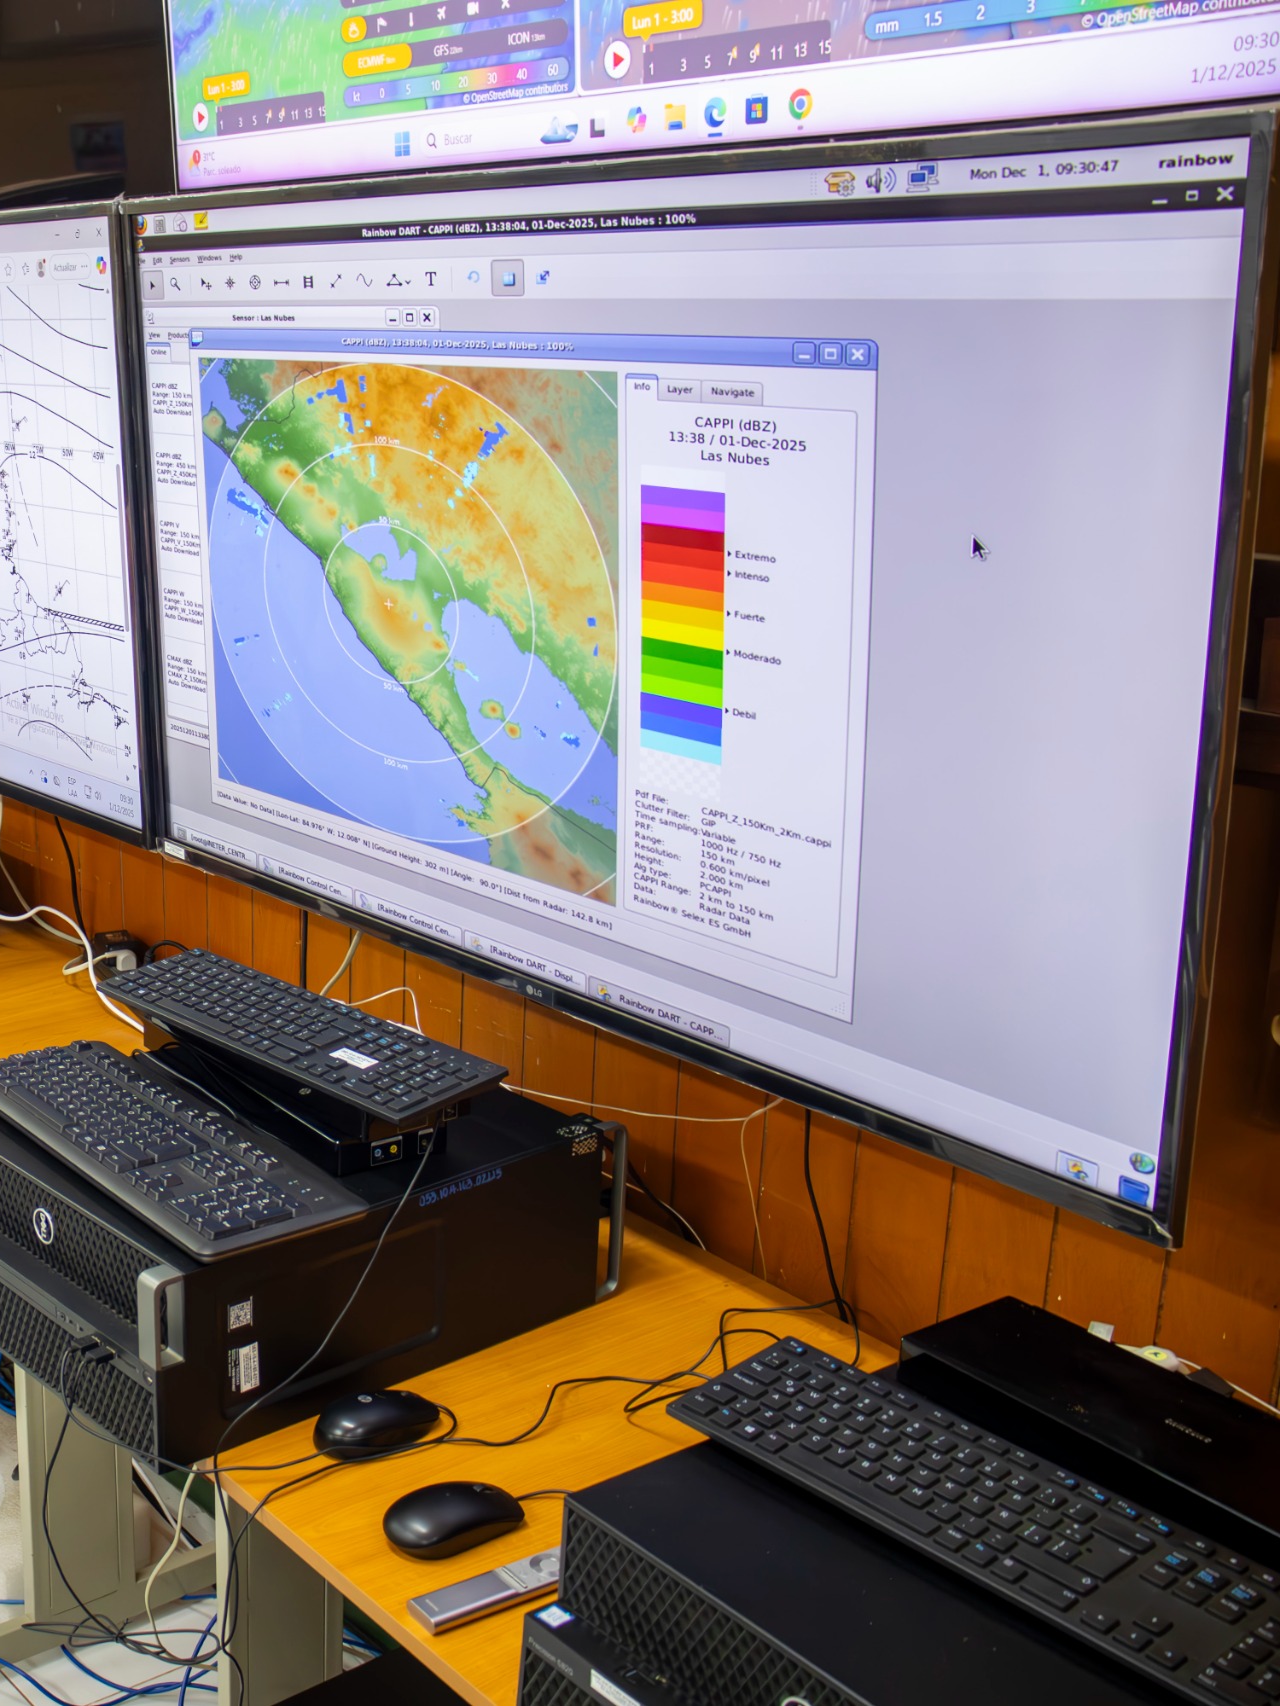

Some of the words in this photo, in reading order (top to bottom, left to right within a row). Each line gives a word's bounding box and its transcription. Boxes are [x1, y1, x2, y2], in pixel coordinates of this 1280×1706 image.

[632, 14, 651, 30] Lun
[654, 12, 660, 25] 1
[671, 7, 694, 23] 3:00
[875, 20, 899, 34] mm
[924, 11, 943, 27] 1.5
[976, 4, 985, 21] 2
[1096, 1, 1199, 27] OpenStreetMap
[507, 32, 530, 45] ICON
[1233, 31, 1280, 52] 09:30
[357, 53, 386, 69] ECMWF
[433, 44, 449, 58] GFS
[680, 58, 687, 71] 3
[704, 55, 711, 69] 5
[749, 50, 757, 63] 9
[770, 45, 783, 61] 11
[794, 42, 807, 58] 13
[819, 39, 832, 55] 15
[1191, 58, 1277, 84] 1/12/2025
[231, 79, 245, 92] 3:00
[353, 91, 361, 103] kt
[379, 88, 385, 98] 0
[405, 84, 411, 95] 5
[431, 80, 441, 91] 10
[458, 76, 468, 88] 20
[487, 72, 497, 85] 30
[516, 68, 528, 81] 40
[547, 63, 559, 75] 60
[471, 89, 524, 104] OpenStreetMap
[525, 82, 568, 97] contributors
[291, 109, 299, 121] 11
[304, 108, 312, 119] 13
[318, 106, 326, 117] 15
[443, 132, 473, 146] Buscar
[969, 167, 997, 181] Mon
[1001, 165, 1027, 179] Dec
[1055, 159, 1119, 176] 09:30:47
[1158, 152, 1233, 170] rainbow
[362, 227, 397, 237] Rainbow
[398, 226, 420, 236] DART
[428, 224, 454, 235] CAPPI
[485, 221, 530, 233] 13:38:04,
[531, 218, 597, 231] 01-Dec-2025,
[600, 217, 618, 228] Las
[621, 214, 655, 226] Nubes
[665, 213, 696, 225] 100%
[53, 262, 77, 273] Actualizar
[170, 256, 190, 265] Sensors
[197, 254, 222, 263] Windows
[229, 253, 243, 263] Help
[232, 314, 257, 322] Sensor
[260, 314, 273, 322] Las
[273, 314, 295, 322] Nubes
[150, 348, 167, 356] Online
[492, 341, 507, 349] Las
[509, 341, 537, 350] Nubes
[634, 382, 651, 391] Info
[667, 385, 693, 395] Layer
[711, 386, 755, 399] Navigate
[694, 417, 734, 430] CAPPI
[739, 419, 777, 434] (dBZ)
[669, 431, 705, 444] 13:38
[719, 435, 807, 452] 01-Dec-2025
[700, 450, 723, 462] Las
[728, 452, 770, 466] Nubes
[735, 550, 776, 563] Extremo
[735, 570, 770, 583] Intenso
[734, 611, 766, 623] Fuerte
[733, 649, 781, 666] Moderado
[31, 704, 64, 724] Windows
[732, 708, 756, 720] Debil
[68, 776, 76, 785] ESP
[635, 789, 649, 800] Pdf
[652, 793, 669, 804] File:
[635, 800, 663, 814] Clutter
[666, 808, 690, 821] Filter:
[701, 818, 716, 828] GIP
[635, 810, 656, 822] Time
[659, 817, 701, 836] sampling:
[701, 829, 736, 845] Variable
[701, 807, 832, 848] CAPPI_Z_150Km_2Km.cappi
[635, 821, 654, 832] PRF:
[701, 839, 723, 852] 1000
[726, 846, 738, 857] Hz
[749, 852, 766, 865] 750
[769, 858, 782, 869] Hz
[635, 831, 665, 846] Range:
[701, 850, 717, 861] 150
[720, 855, 735, 866] km
[634, 842, 681, 862] Resolution:
[700, 861, 726, 875] 0.600
[729, 868, 771, 888] km/pixel
[634, 852, 664, 867] Height:
[700, 871, 726, 885] 2.000
[729, 880, 744, 891] km
[278, 866, 305, 883] [Rainbow
[306, 876, 328, 891] Control
[634, 862, 647, 874] Alg
[649, 866, 671, 880] type:
[700, 882, 732, 898] PCAPPI
[425, 860, 437, 871] 302
[504, 886, 521, 899] [Dist
[523, 891, 540, 905] from
[542, 899, 569, 916] Radar:
[571, 909, 594, 924] 142.8
[596, 917, 612, 931] km]
[634, 872, 659, 886] CAPPI
[661, 879, 692, 896] Range:
[708, 894, 723, 906] km
[726, 899, 736, 910] to
[739, 903, 756, 916] 150
[759, 910, 774, 922] km
[634, 883, 656, 896] Data:
[699, 903, 726, 919] Radar
[729, 913, 750, 926] Data
[681, 910, 705, 924] Selex
[709, 918, 720, 929] ES
[723, 923, 752, 939] GmbH
[489, 944, 524, 965] [Rainbow
[526, 957, 547, 973] DART
[619, 994, 656, 1016] Rainbow
[657, 1008, 681, 1025] DART
